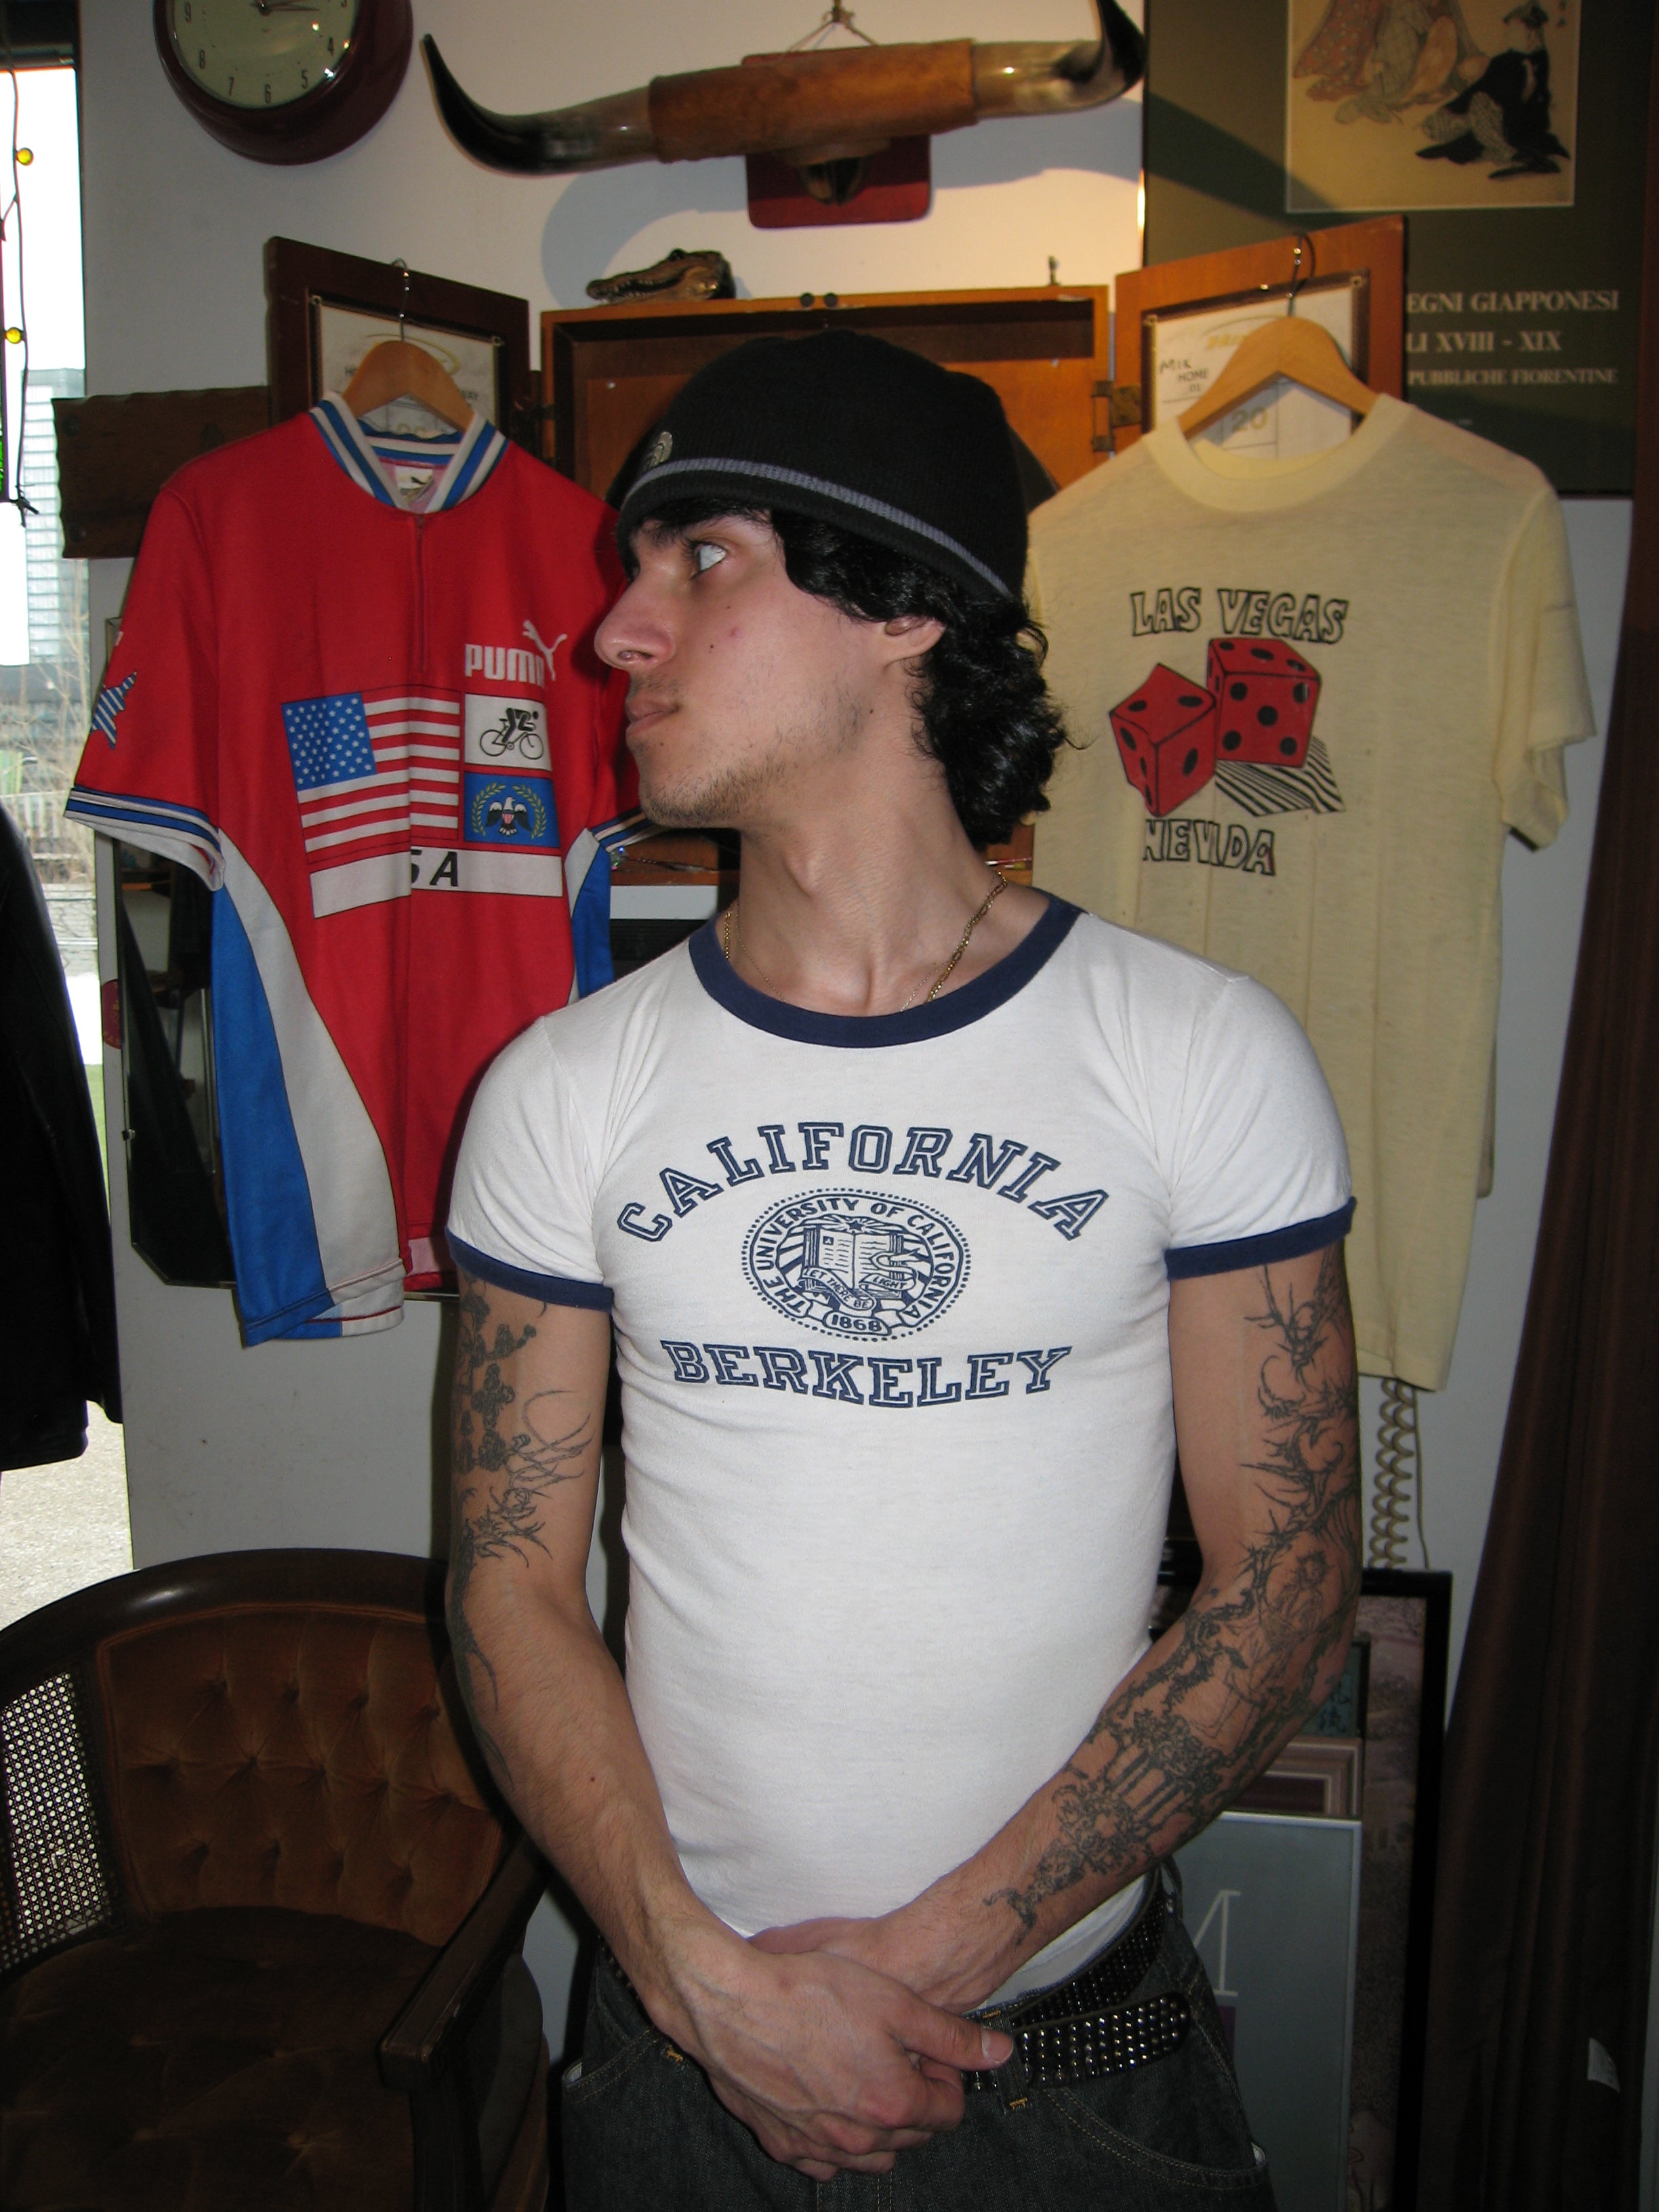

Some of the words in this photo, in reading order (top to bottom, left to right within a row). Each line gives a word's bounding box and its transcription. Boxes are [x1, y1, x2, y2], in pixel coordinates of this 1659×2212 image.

[228, 76, 234, 96] 7
[300, 69, 309, 89] 5
[264, 84, 272, 103] 6
[1406, 291, 1463, 313] EGNI
[1471, 290, 1619, 312] GIAPPONESI
[1406, 332, 1428, 352] LI
[1436, 331, 1495, 352] XVIII
[1519, 331, 1561, 352] XIX
[1408, 369, 1507, 386] PUBBLICHE
[1512, 368, 1618, 384] FIORENTINE
[1130, 586, 1202, 636] LAS
[1217, 588, 1349, 644] VEGAS
[617, 1122, 1109, 1242] CALIFORNIA
[870, 1202, 905, 1218] OF
[757, 1197, 859, 1271] UNIVERSITY
[904, 1214, 955, 1319] CALIFORNIA
[763, 1275, 806, 1313] THE
[803, 1268, 828, 1279] LET
[827, 1277, 854, 1302] THERE
[853, 1299, 870, 1309] BE
[873, 1275, 908, 1289] LIGHT
[832, 1313, 882, 1332] 1868
[660, 1339, 1073, 1408] BERKELEY
